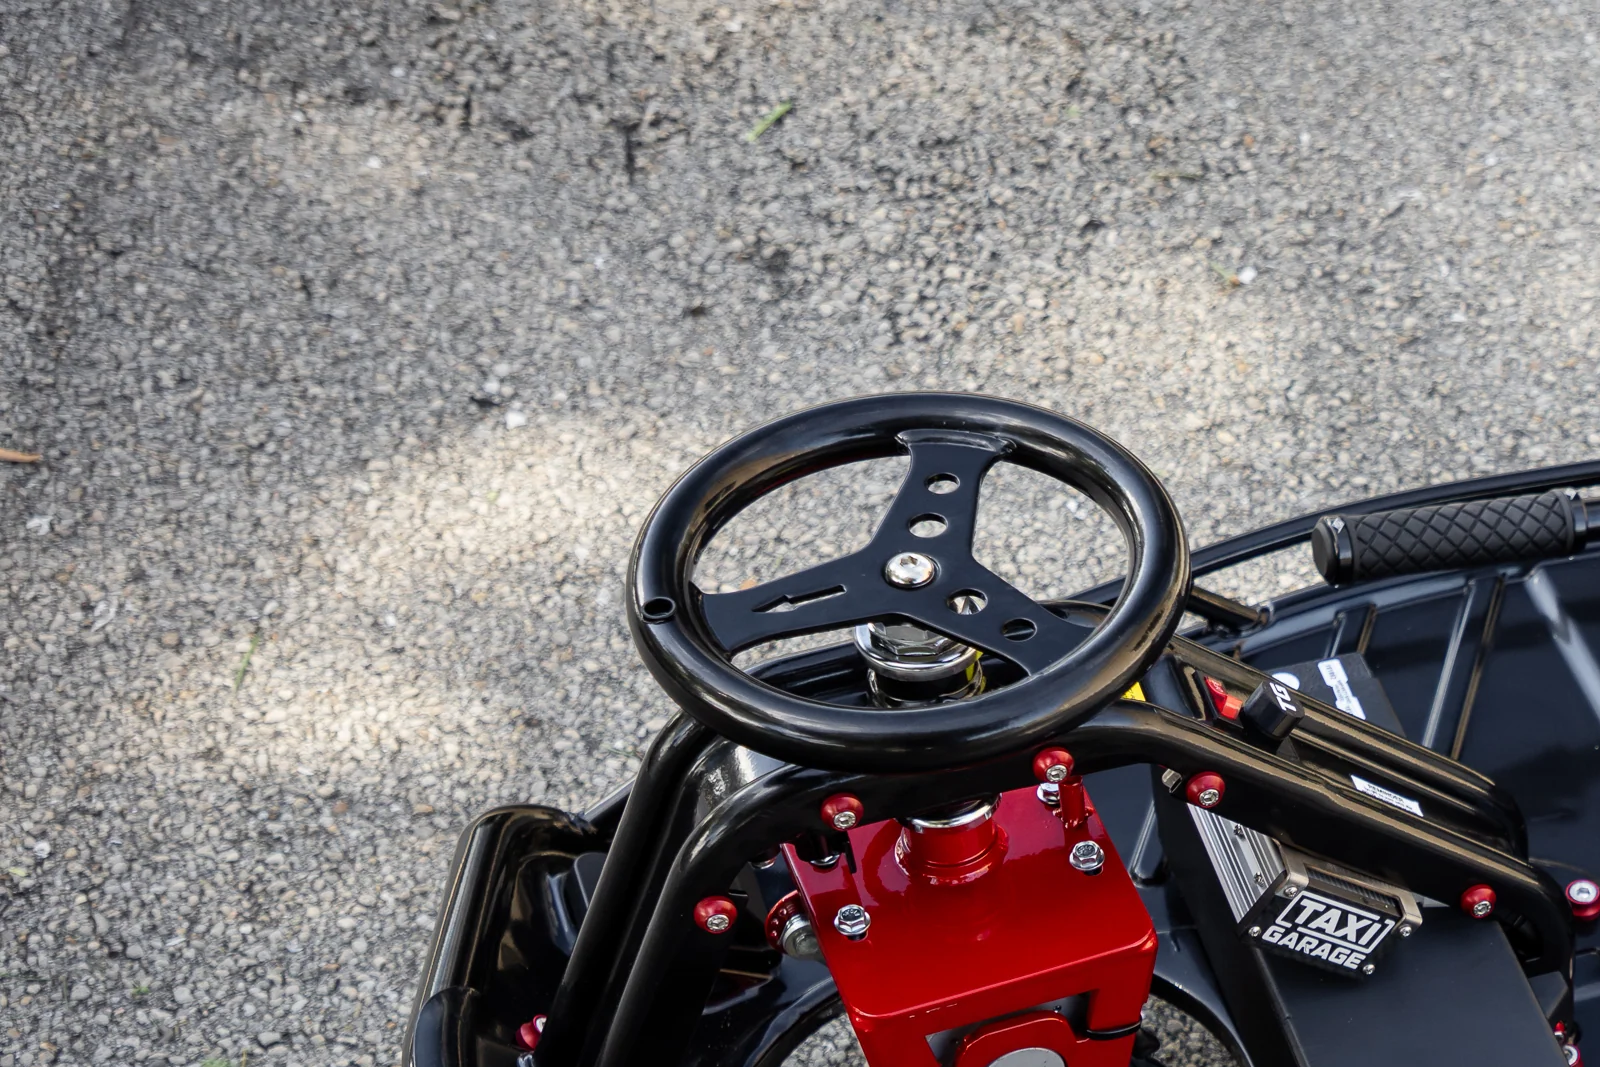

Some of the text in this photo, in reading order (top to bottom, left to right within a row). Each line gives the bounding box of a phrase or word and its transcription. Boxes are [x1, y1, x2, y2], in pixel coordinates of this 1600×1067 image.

[1269, 682, 1297, 711] TG
[1294, 898, 1382, 946] TAXI
[1262, 925, 1366, 970] GARAGE
